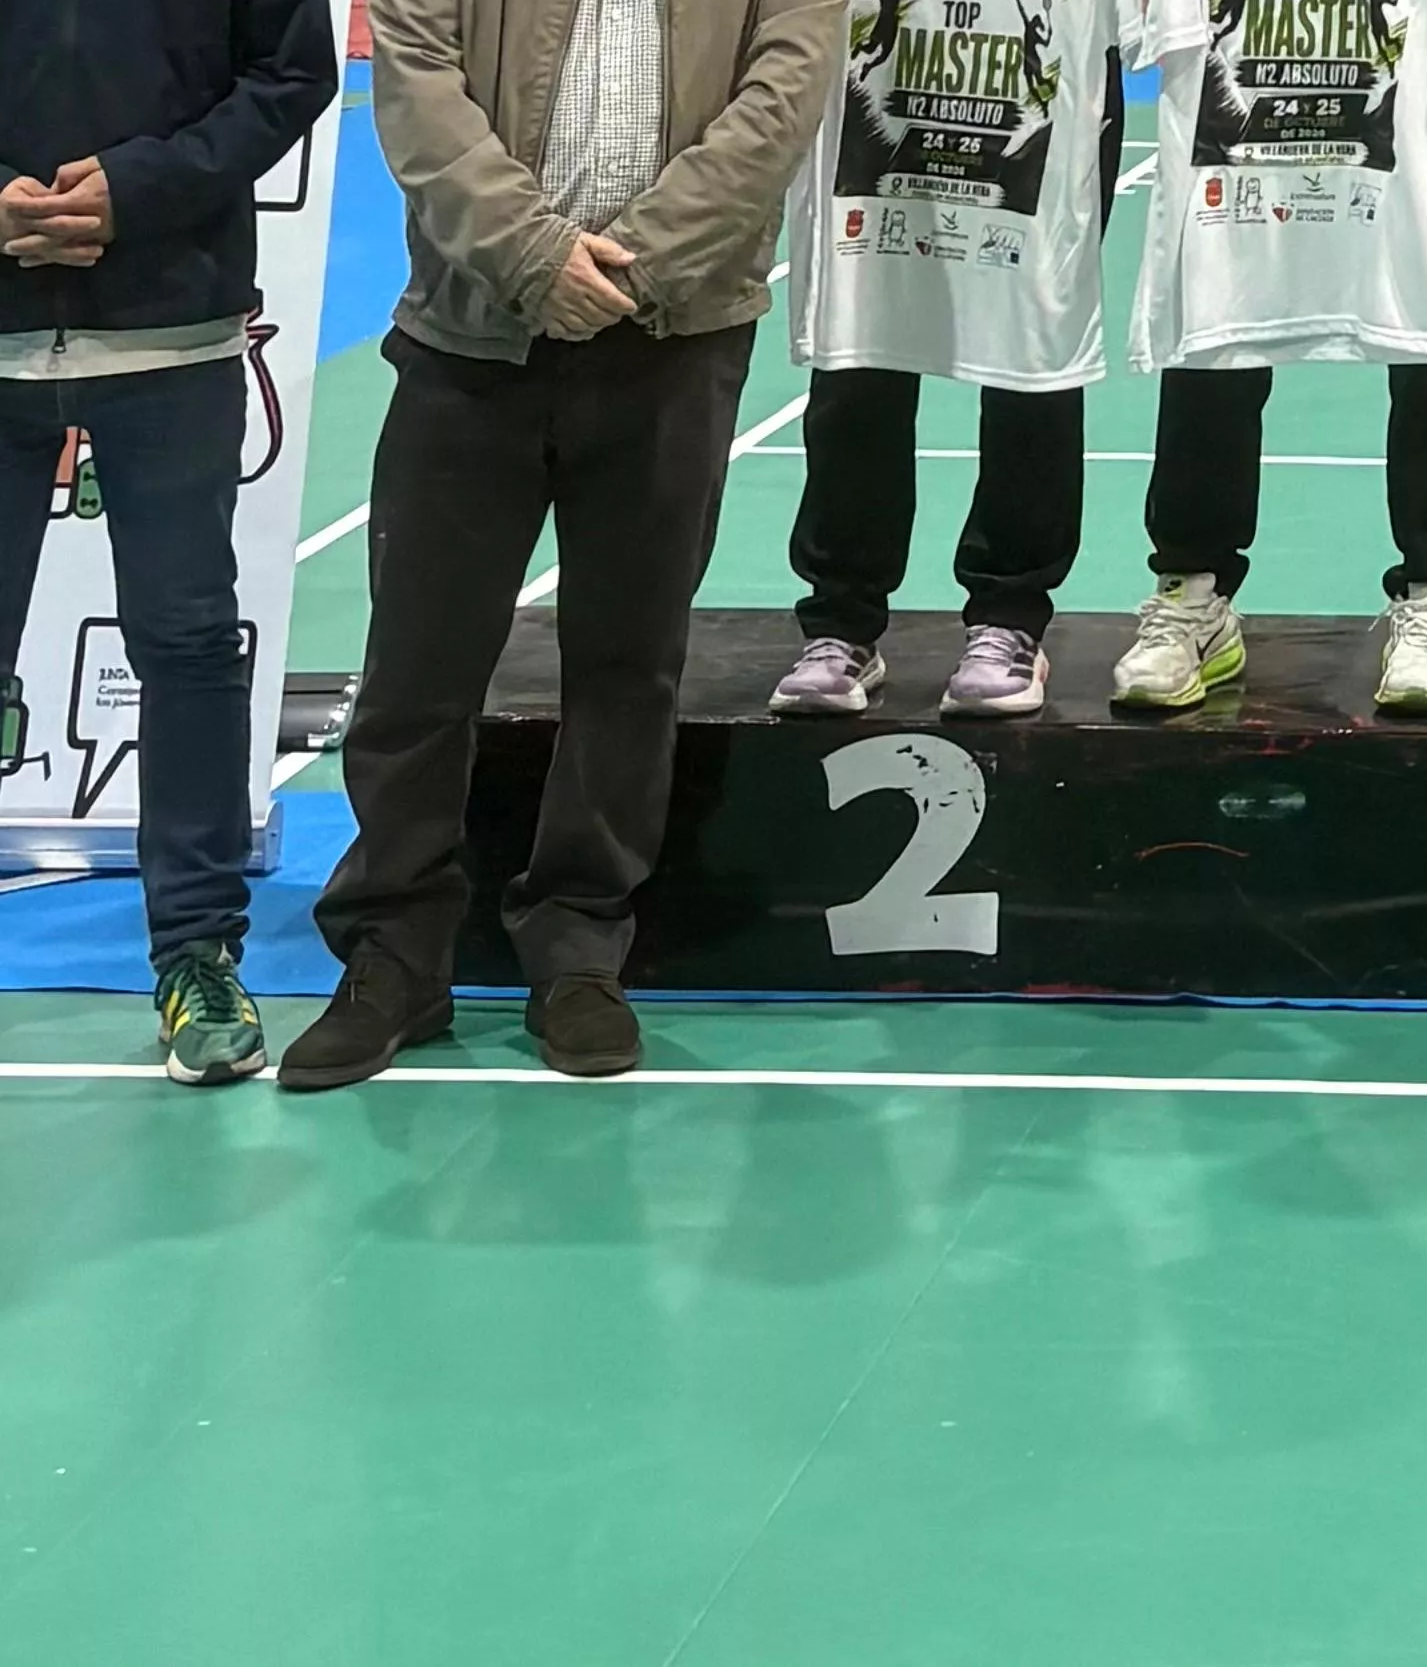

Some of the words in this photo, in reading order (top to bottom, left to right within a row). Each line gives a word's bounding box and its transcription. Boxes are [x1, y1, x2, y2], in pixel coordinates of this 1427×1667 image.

[943, 0, 980, 29] TOP
[894, 28, 1025, 99] MASTER
[1281, 63, 1359, 87] ABSOLUTO
[822, 731, 999, 957] 2
